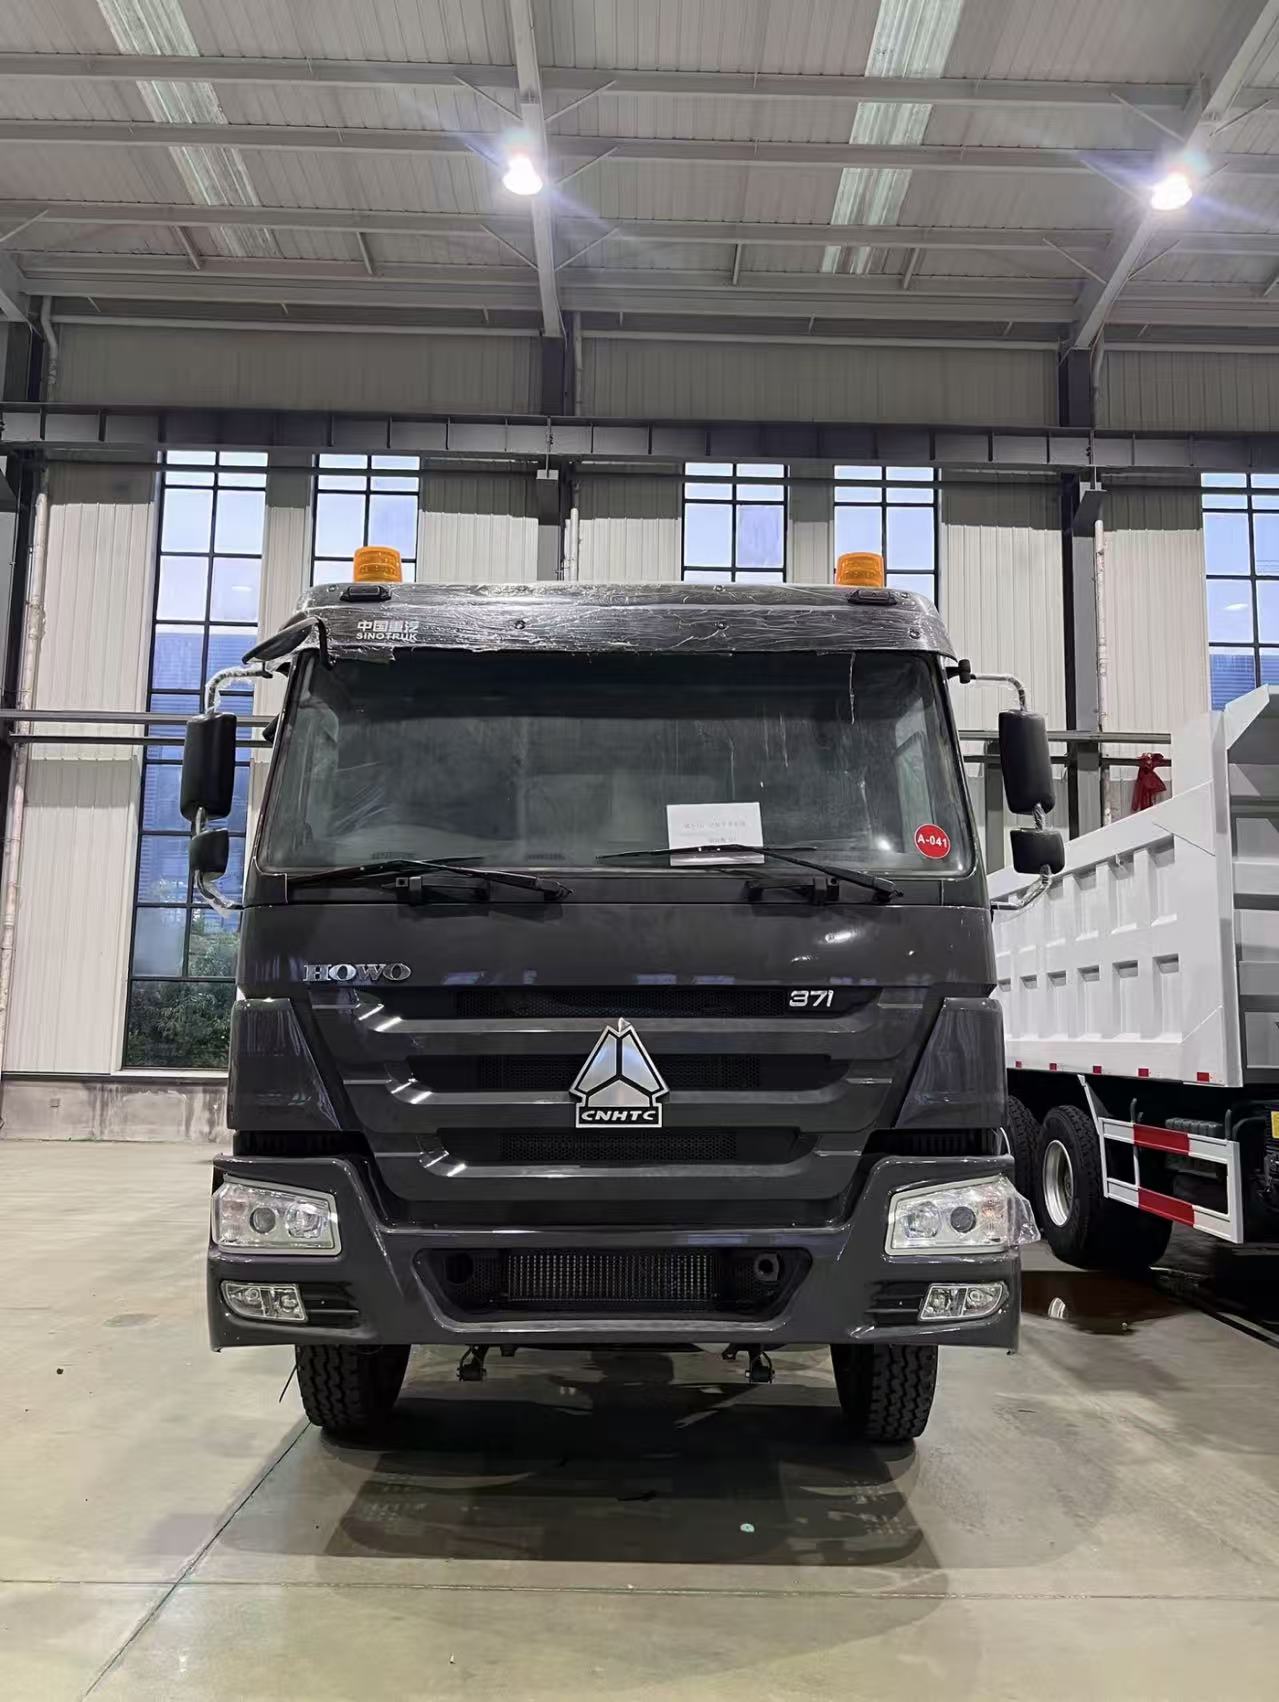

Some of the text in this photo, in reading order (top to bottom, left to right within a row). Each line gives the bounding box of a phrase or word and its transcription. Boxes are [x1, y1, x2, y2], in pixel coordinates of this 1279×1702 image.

[356, 632, 418, 641] SINOTRUK
[917, 833, 948, 849] A-041
[303, 963, 412, 982] HOWO
[789, 990, 834, 1007] 371
[581, 1110, 656, 1121] CNHTC
